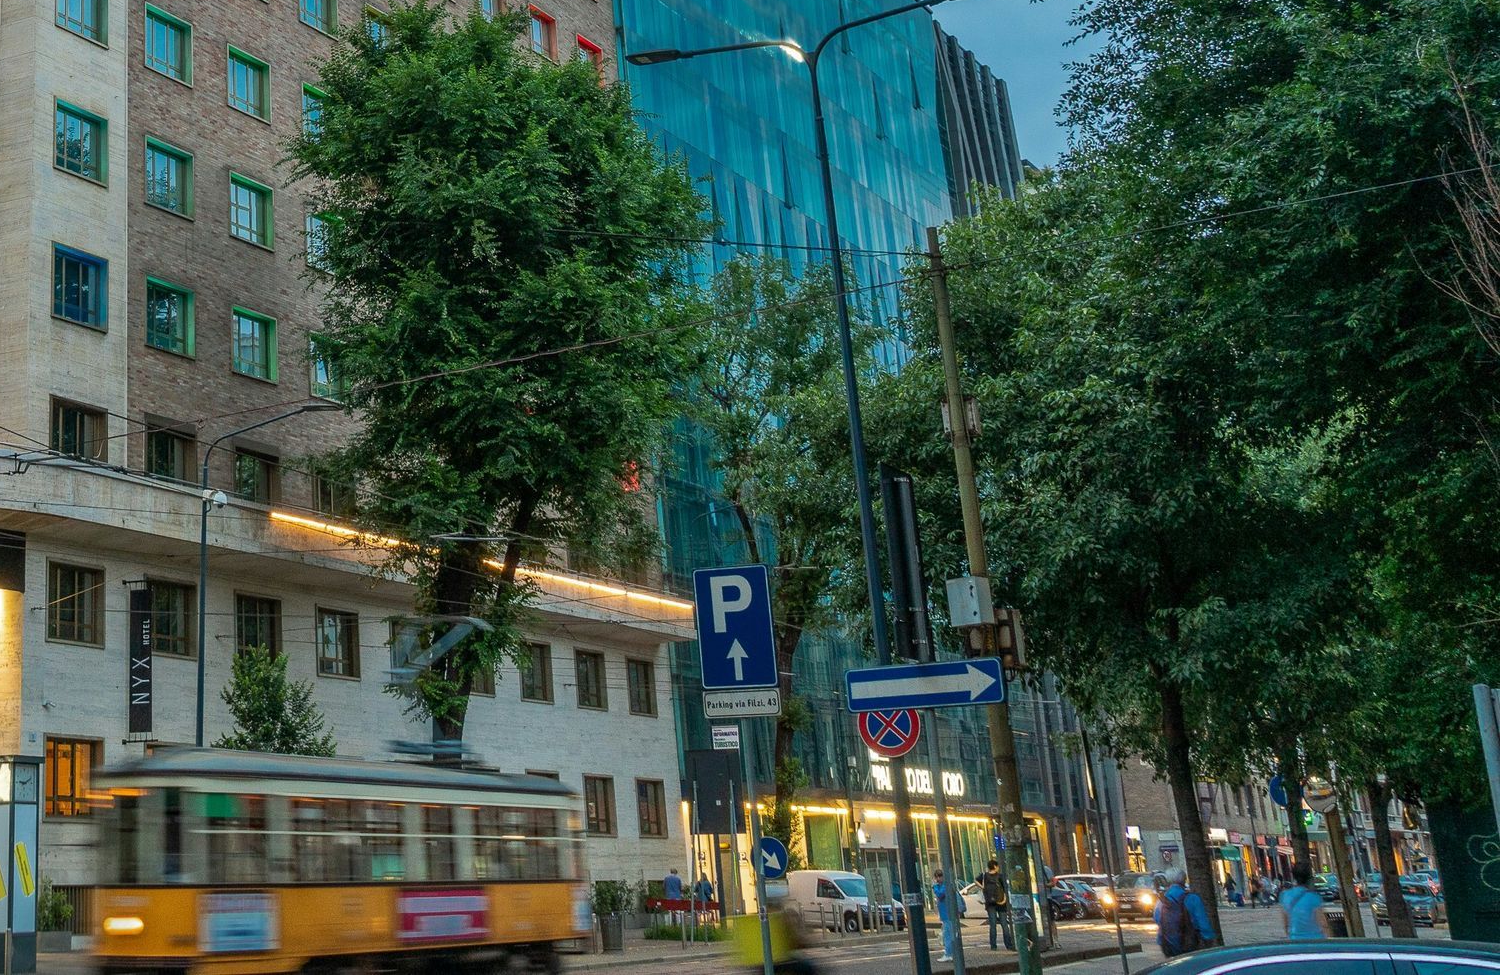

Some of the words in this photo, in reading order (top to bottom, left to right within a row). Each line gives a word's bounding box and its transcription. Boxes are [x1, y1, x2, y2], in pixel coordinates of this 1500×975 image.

[709, 574, 752, 634] P
[142, 619, 150, 645] HOTEL
[131, 656, 150, 705] NYX
[706, 700, 733, 709] Parking
[735, 699, 746, 708] via
[767, 697, 777, 706] 43
